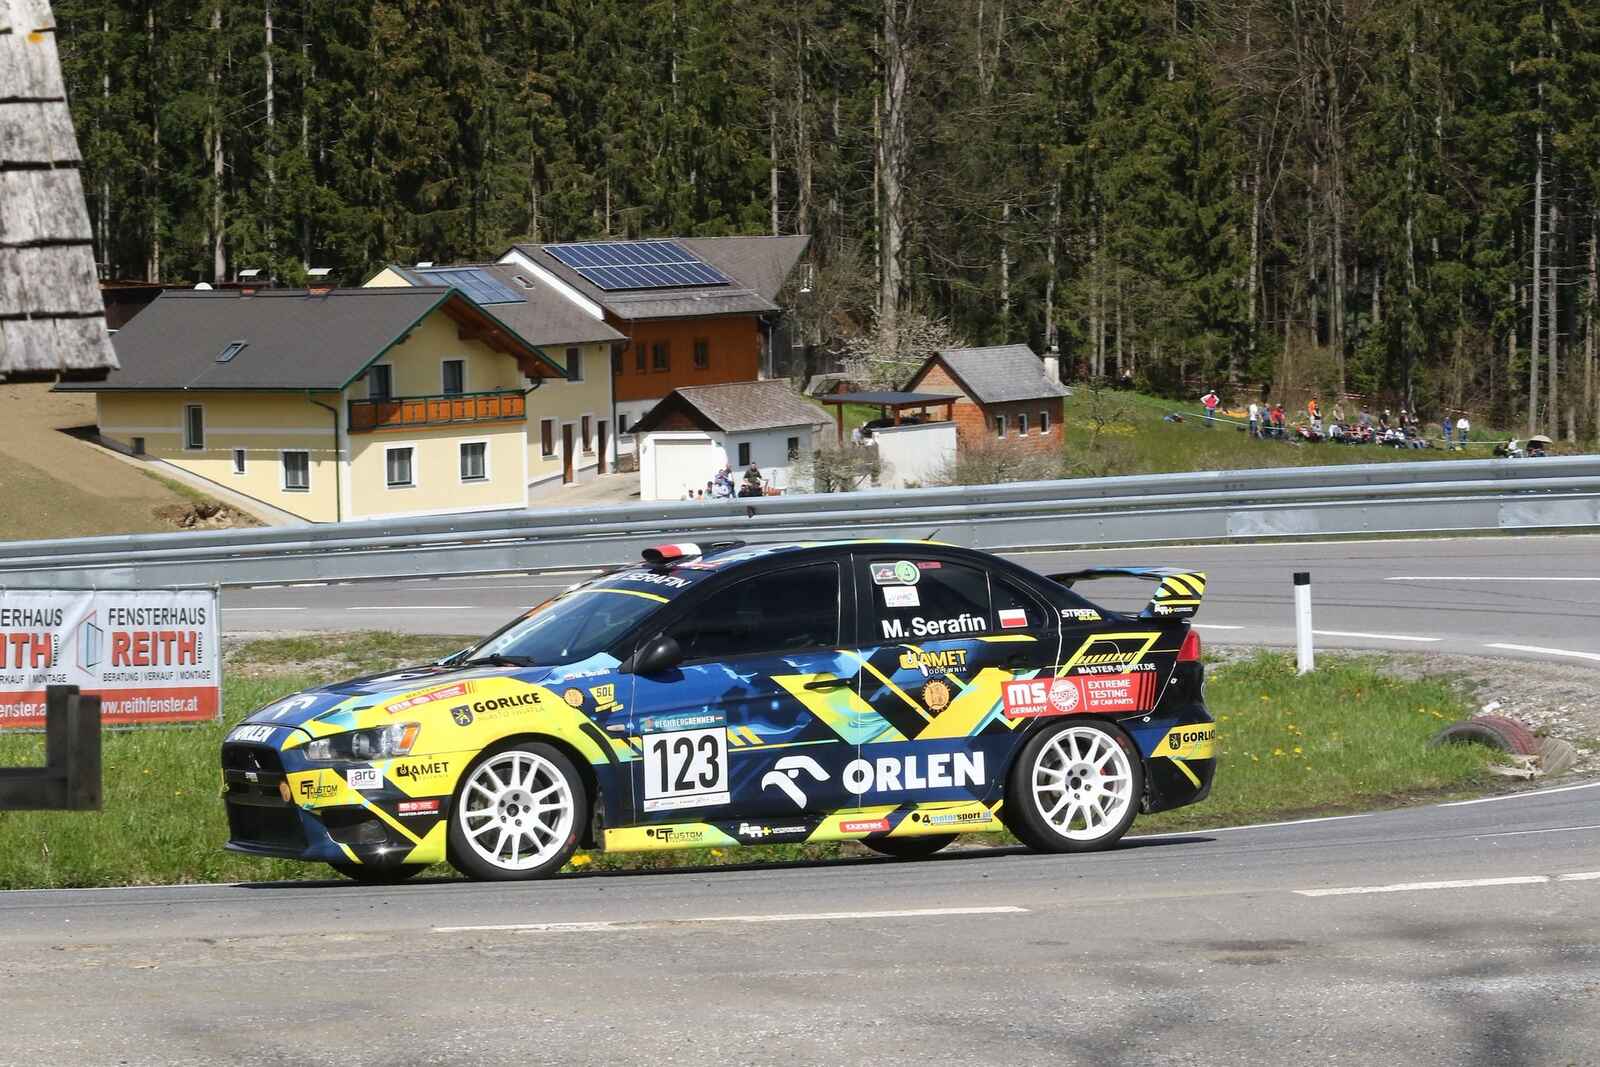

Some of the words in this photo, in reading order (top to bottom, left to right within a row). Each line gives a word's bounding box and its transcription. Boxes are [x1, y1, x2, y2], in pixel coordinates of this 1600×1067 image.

[108, 607, 206, 626] FENSTERHAUS
[881, 619, 909, 639] M.
[911, 613, 987, 636] Serafin
[112, 630, 197, 667] REITH
[103, 672, 138, 682] BERATUNG
[144, 671, 174, 681] VERKAUF
[180, 670, 211, 680] MONTAGE
[1088, 679, 1132, 689] EXTREME
[473, 692, 542, 713] GORLICE
[1089, 689, 1128, 699] TESTING
[1009, 705, 1048, 715] GERMANY
[653, 734, 720, 793] 123
[842, 750, 986, 795] ORLEN
[669, 831, 704, 840] CUSTOM
